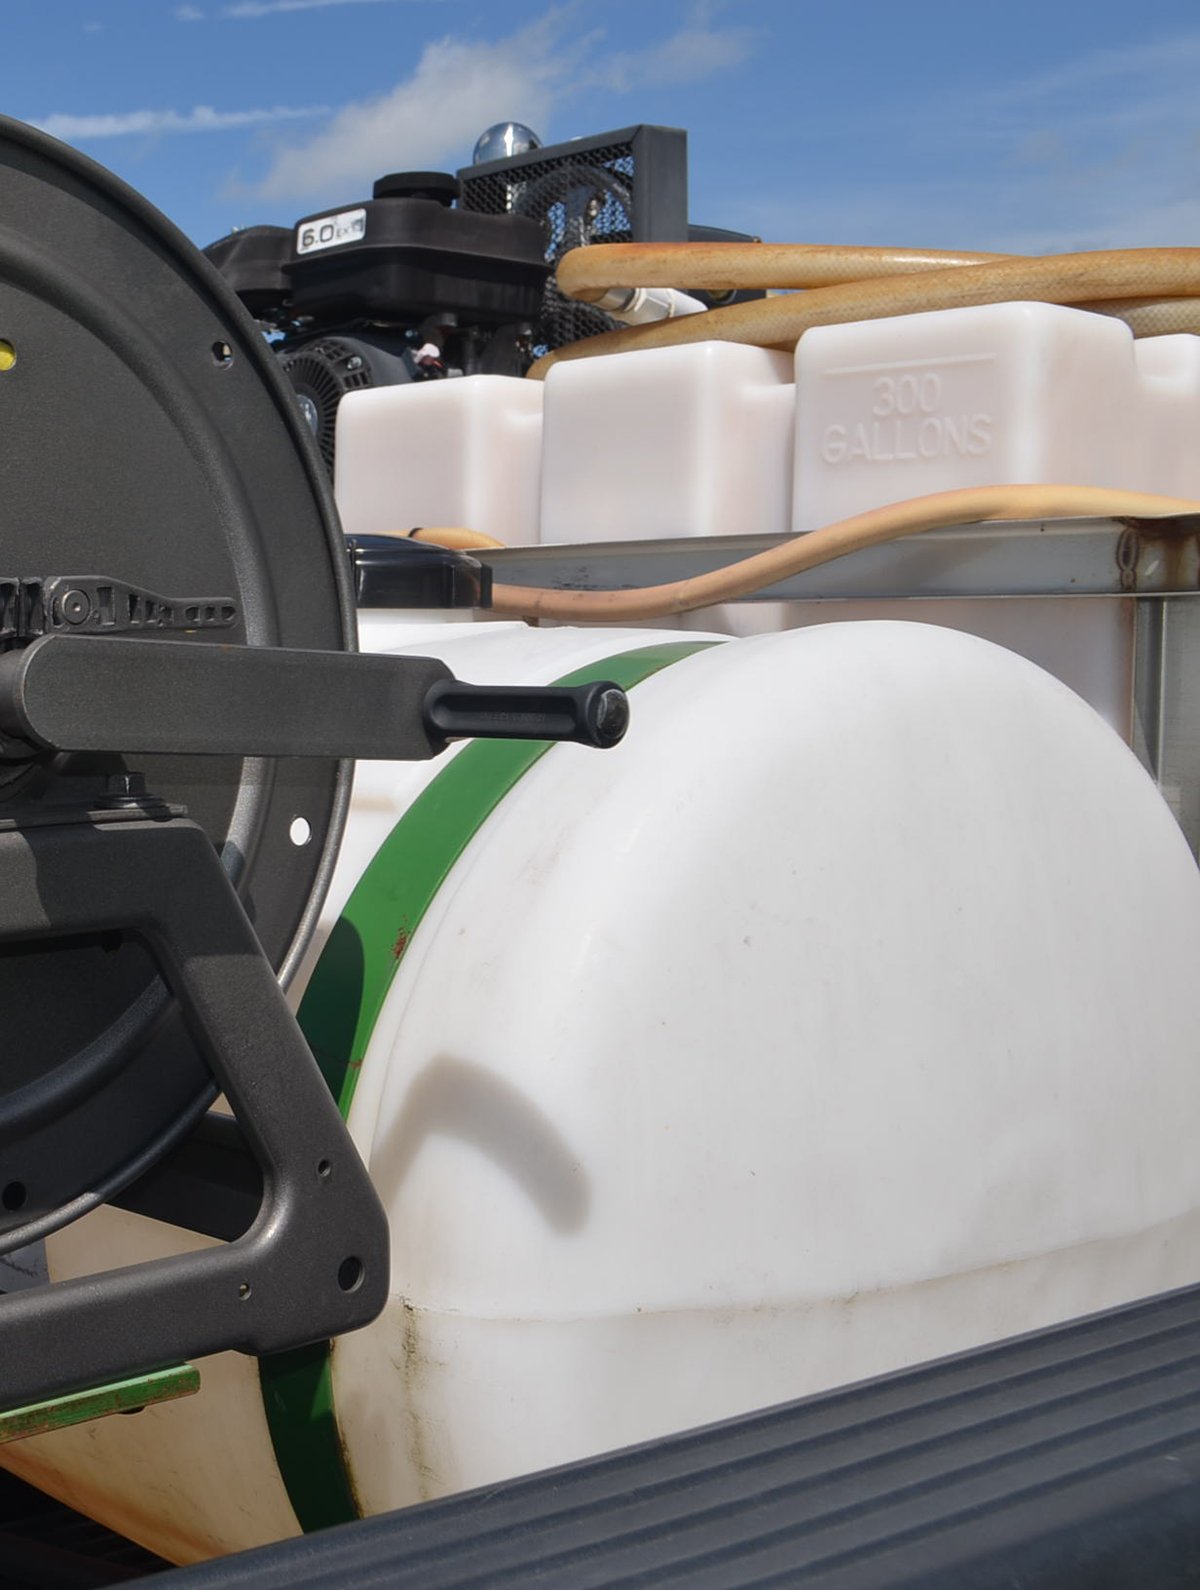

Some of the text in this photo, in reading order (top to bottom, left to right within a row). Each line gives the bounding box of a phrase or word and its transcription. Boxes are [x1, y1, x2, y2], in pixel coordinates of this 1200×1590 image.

[302, 224, 334, 247] 6.0
[872, 371, 942, 416] 300
[821, 412, 993, 464] GALLONS
